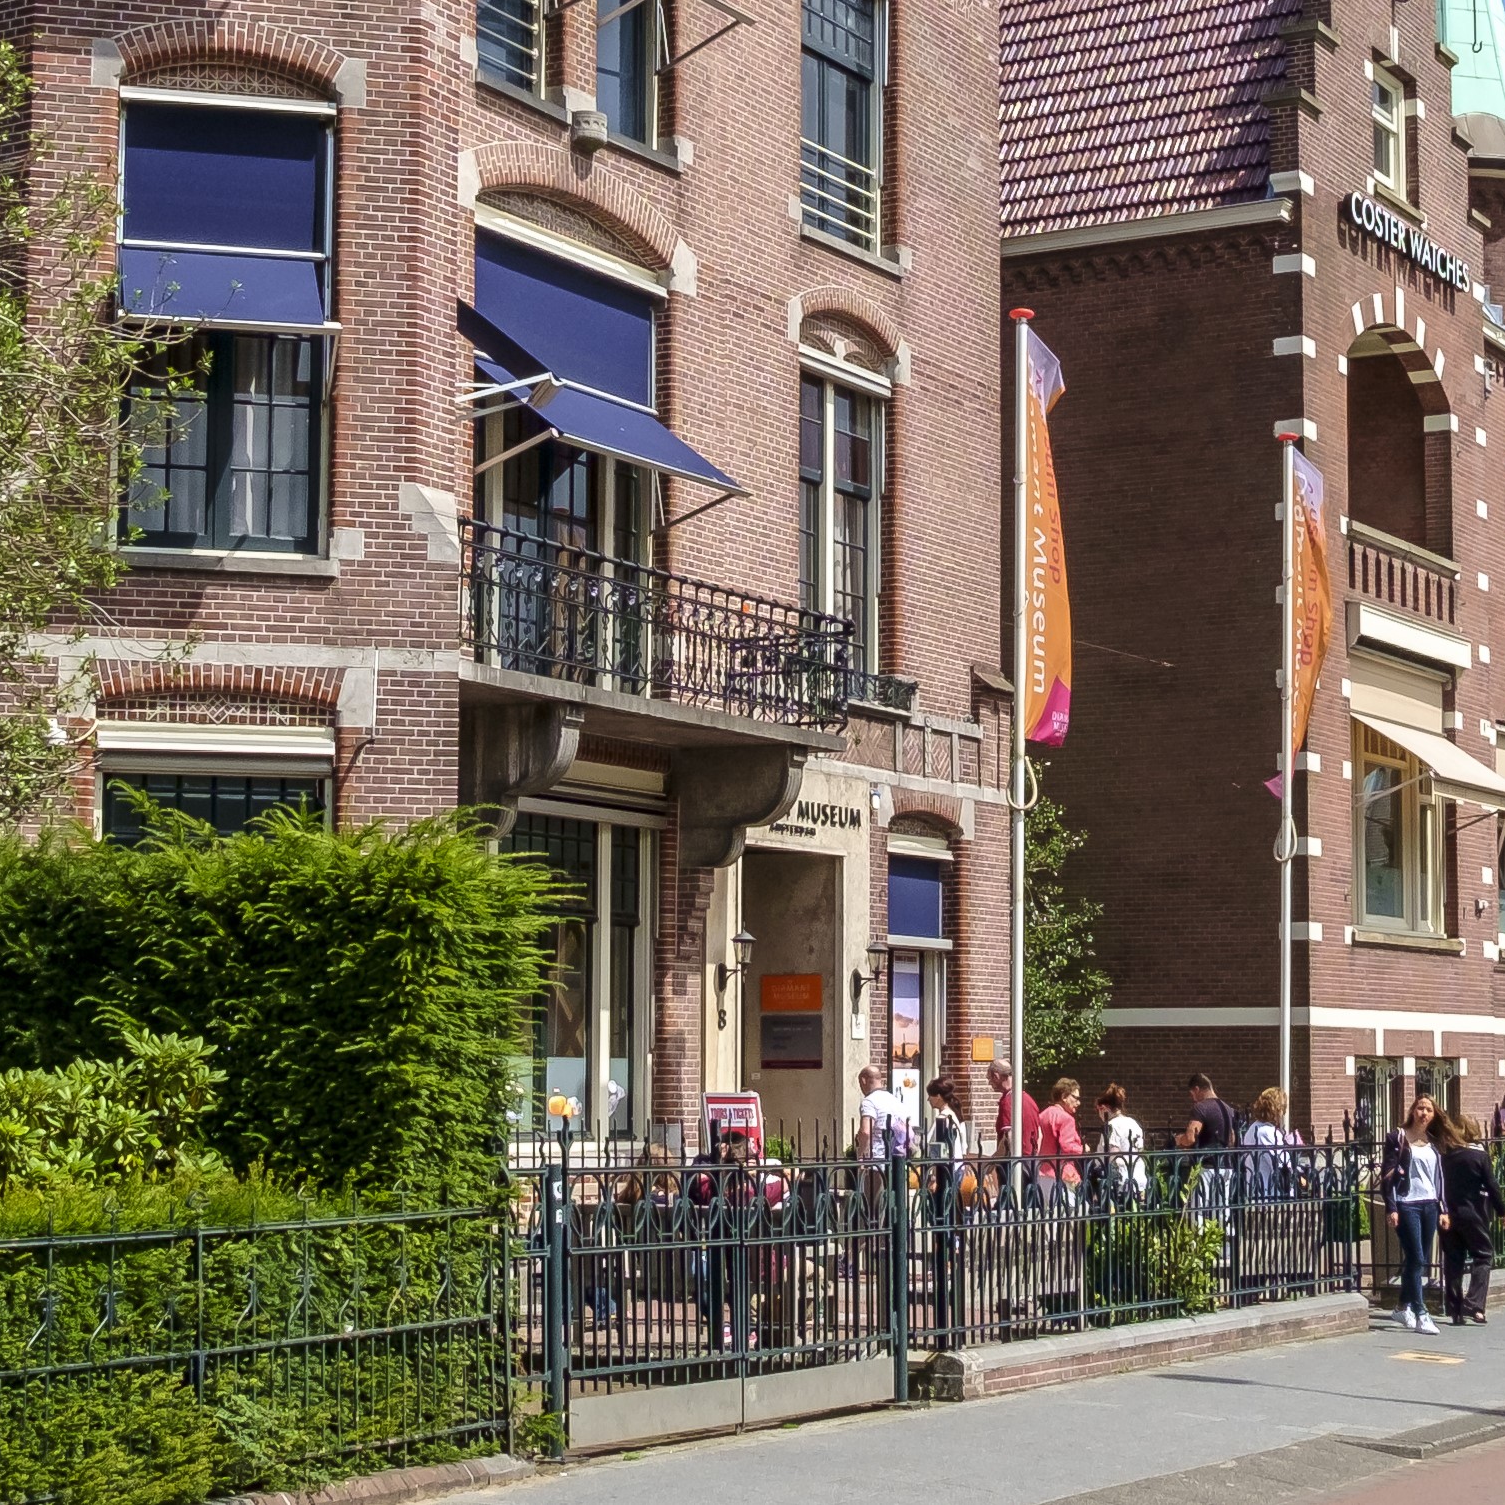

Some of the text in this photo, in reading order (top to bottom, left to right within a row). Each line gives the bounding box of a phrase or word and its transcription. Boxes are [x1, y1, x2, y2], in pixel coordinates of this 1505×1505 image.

[1351, 191, 1471, 294] COSTER WATCHES
[1032, 526, 1048, 695] Museum
[797, 800, 861, 832] MUSEUM
[717, 1008, 727, 1031] 8
